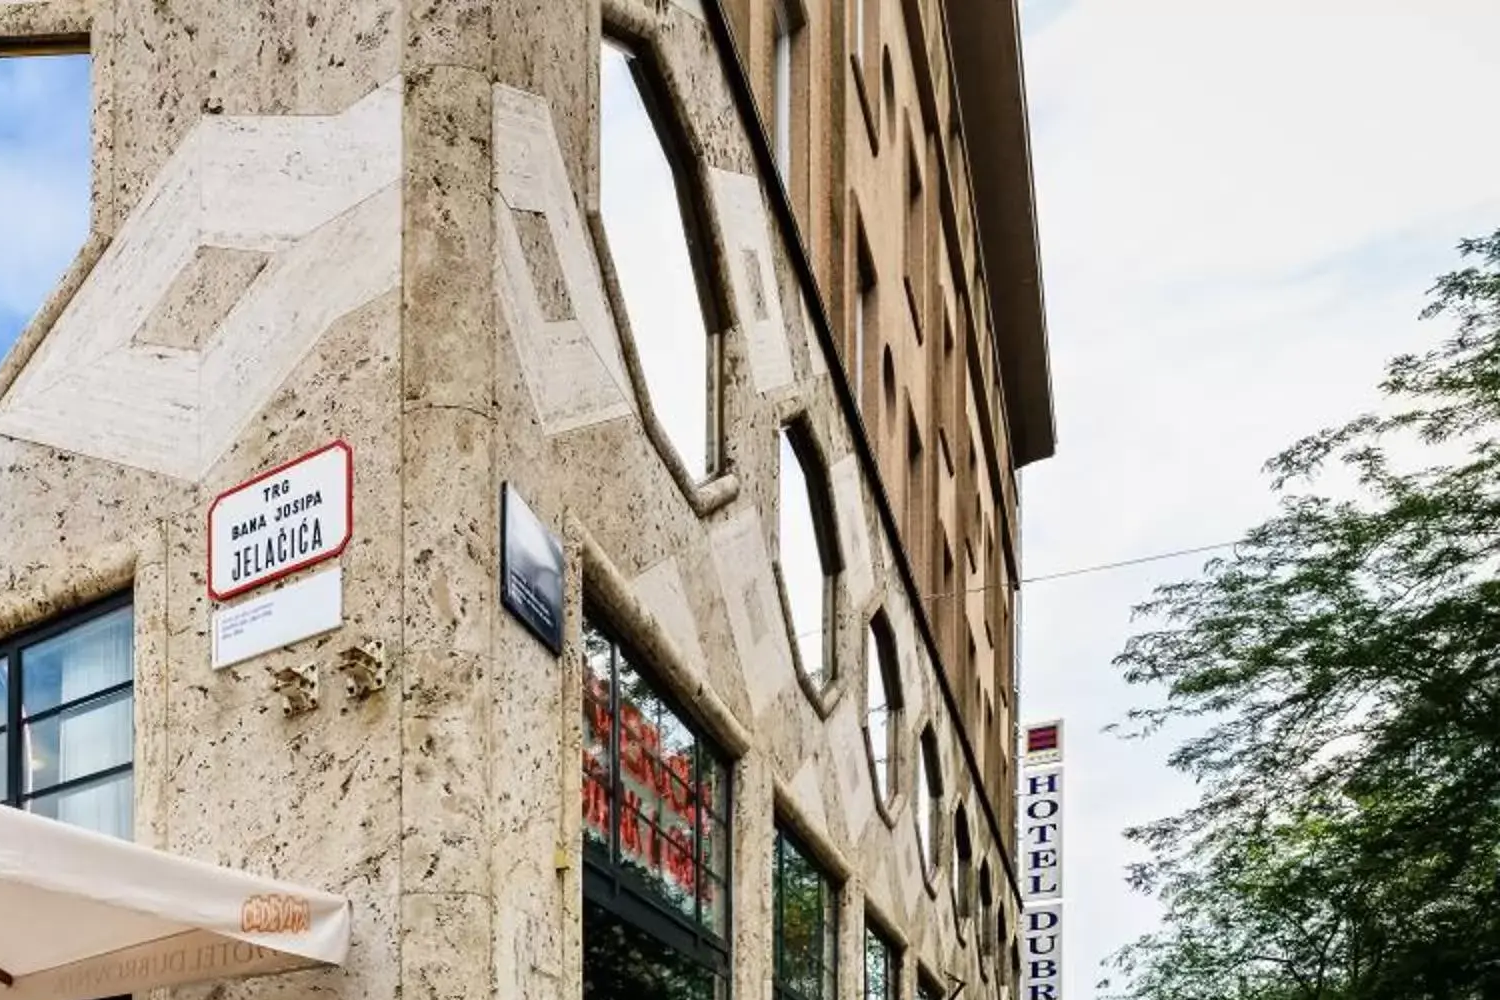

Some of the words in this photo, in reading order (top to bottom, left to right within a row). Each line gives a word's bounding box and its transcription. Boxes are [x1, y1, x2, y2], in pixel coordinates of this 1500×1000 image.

[263, 479, 291, 503] TRG
[274, 490, 323, 523] JOSIPA
[231, 517, 324, 582] JELAČIĆA
[1027, 773, 1059, 896] HOTEL
